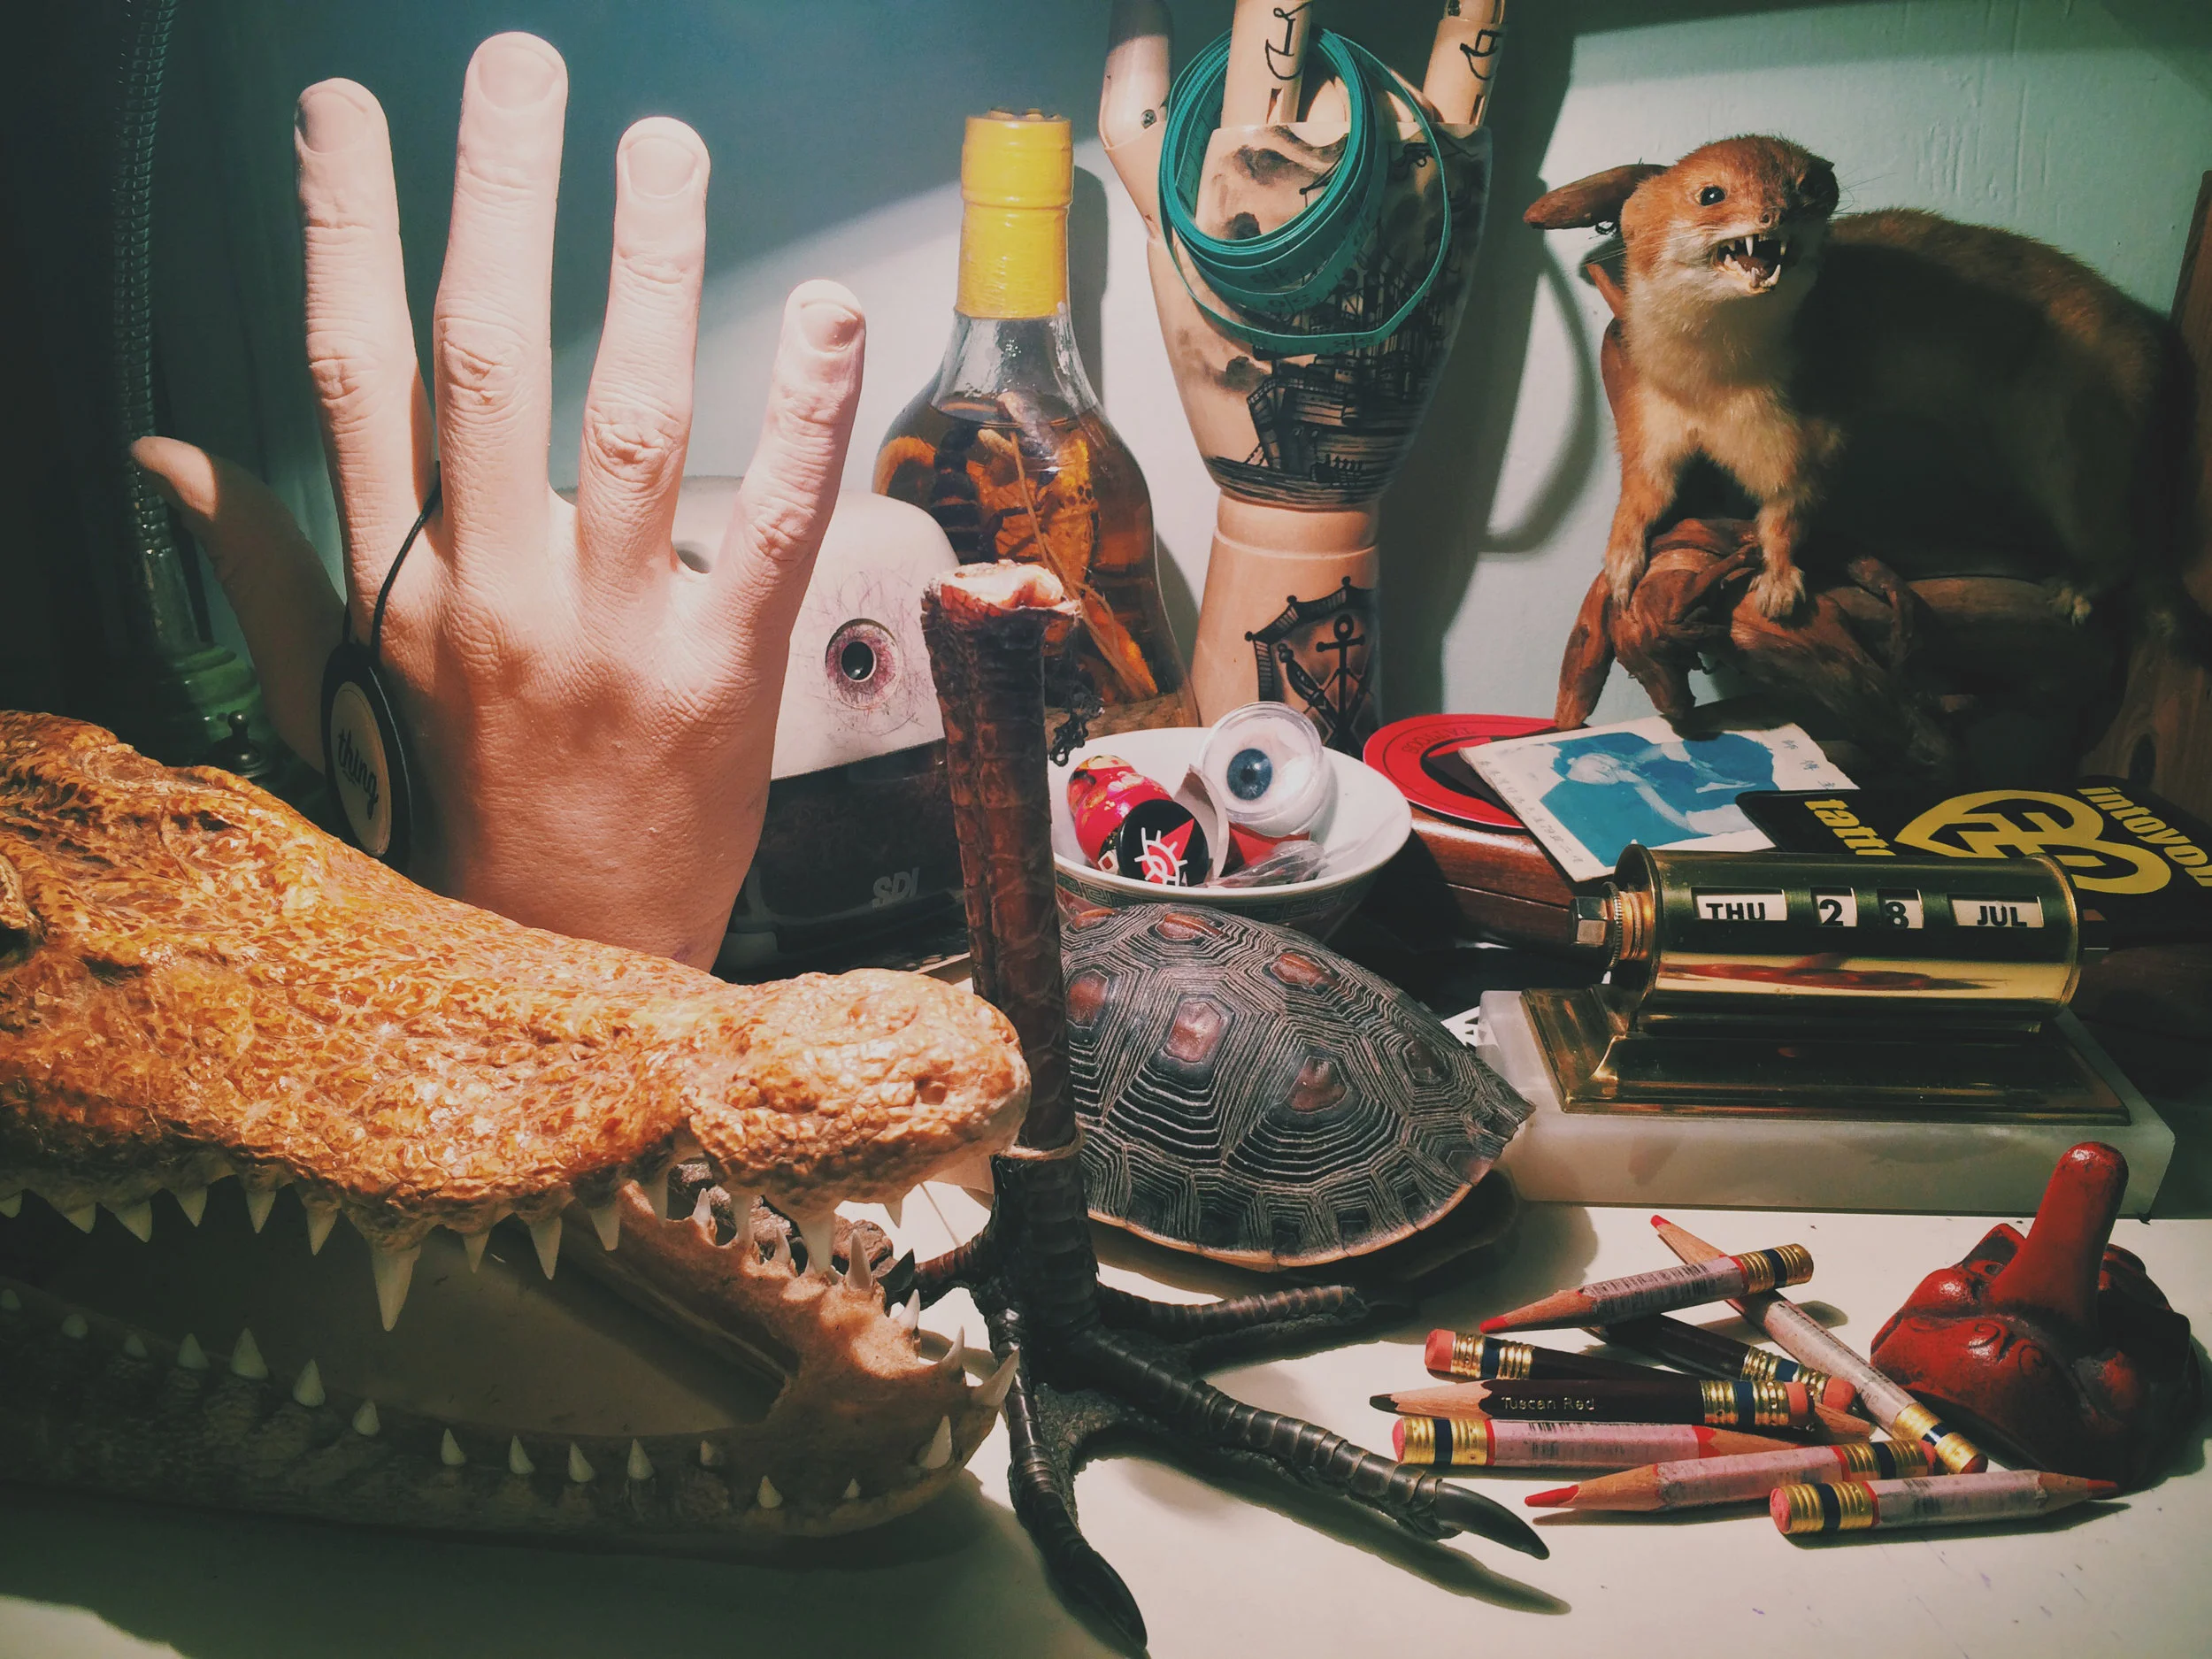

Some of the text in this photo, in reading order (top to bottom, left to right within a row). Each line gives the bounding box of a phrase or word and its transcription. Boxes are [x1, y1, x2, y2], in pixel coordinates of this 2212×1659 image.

[337, 728, 380, 821] thing
[1705, 894, 2028, 929] THU 2 8 JUL
[1501, 1396, 1595, 1411] Tuscan Red
